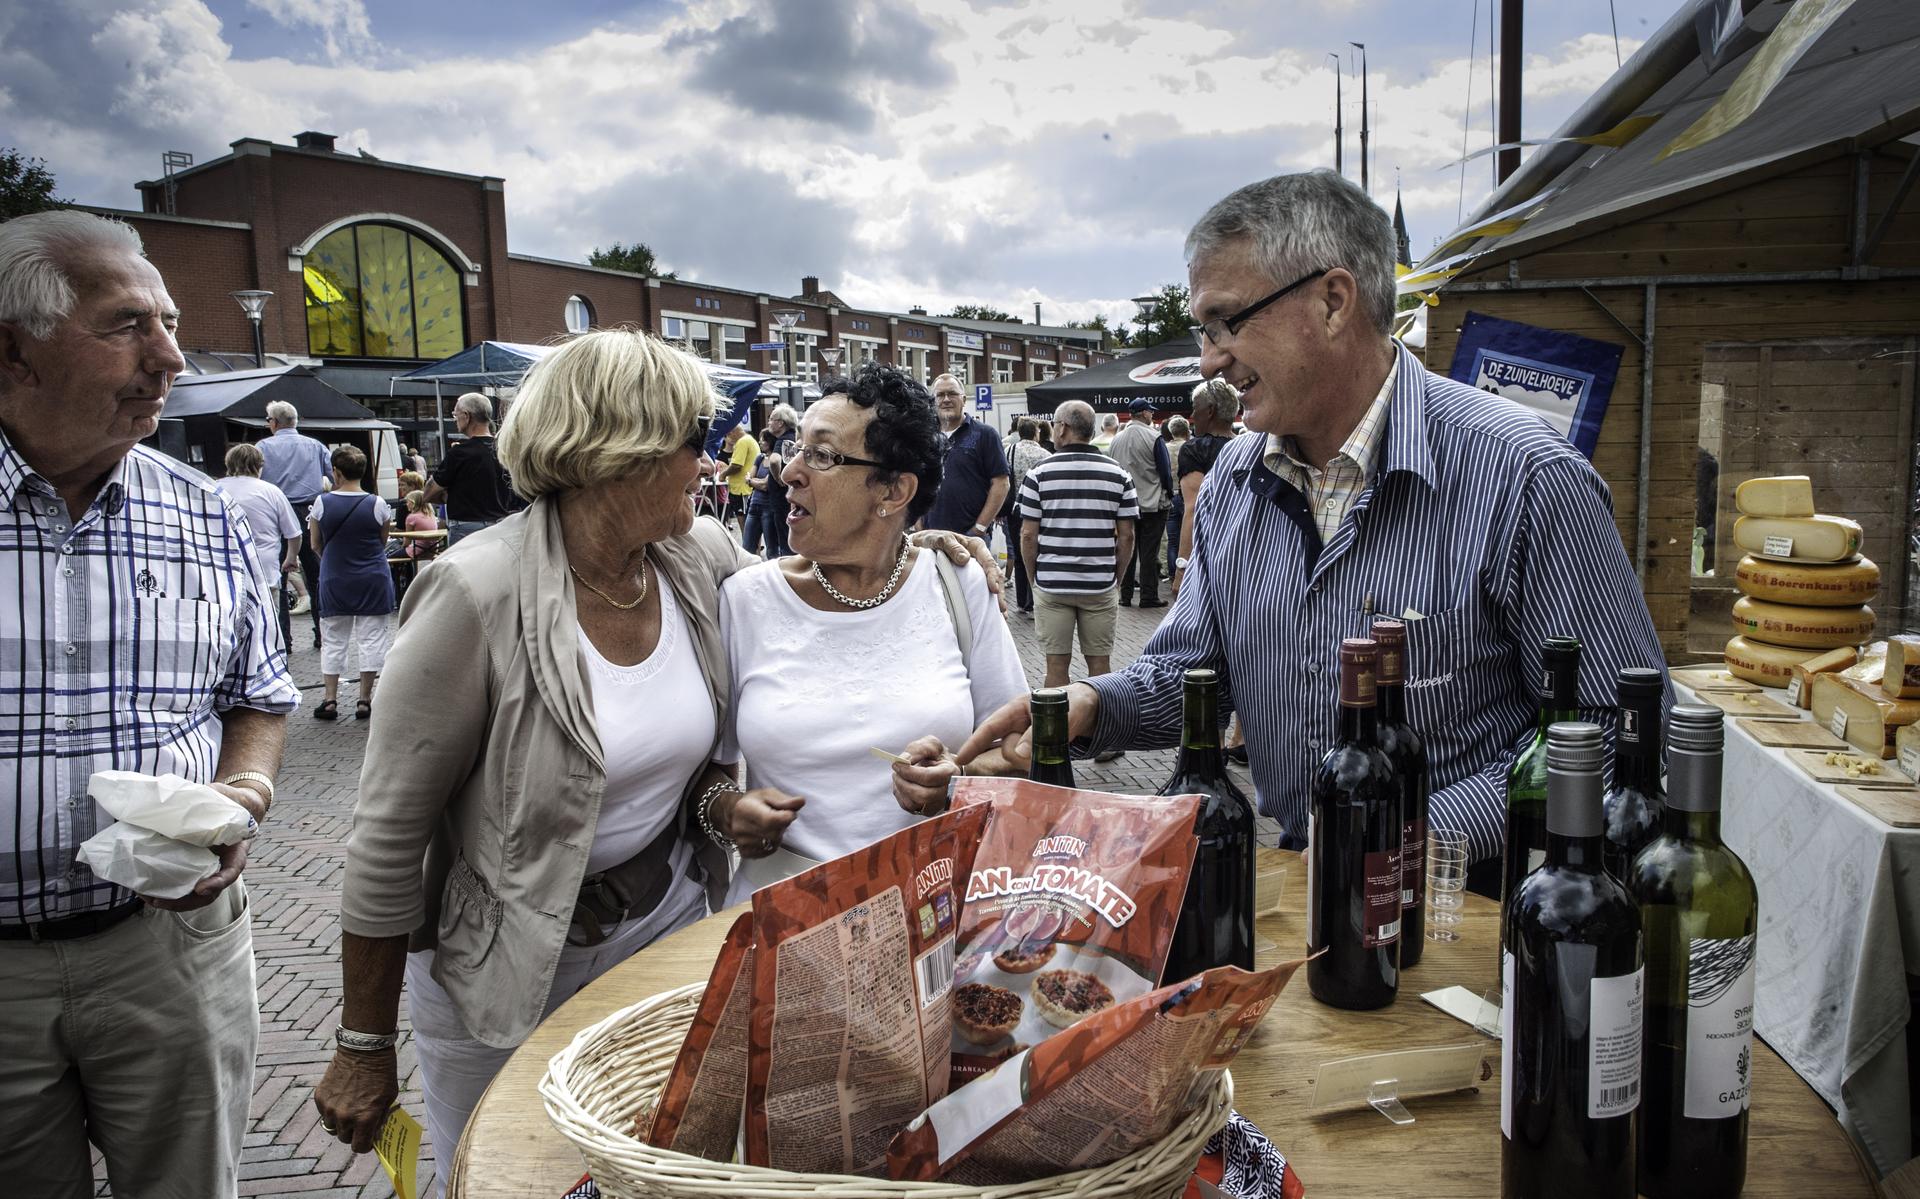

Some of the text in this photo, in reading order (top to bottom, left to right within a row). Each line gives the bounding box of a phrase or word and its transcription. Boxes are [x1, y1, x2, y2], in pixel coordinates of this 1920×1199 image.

[1488, 361, 1576, 395] DE ZUIVELHOEVE
[978, 387, 989, 401] P
[1094, 394, 1101, 404] il
[1770, 577, 1843, 591] Boerenkaas
[1785, 623, 1855, 634] Boerenkaas
[1032, 835, 1086, 858] ANITIN
[1034, 865, 1137, 927] TOMATE
